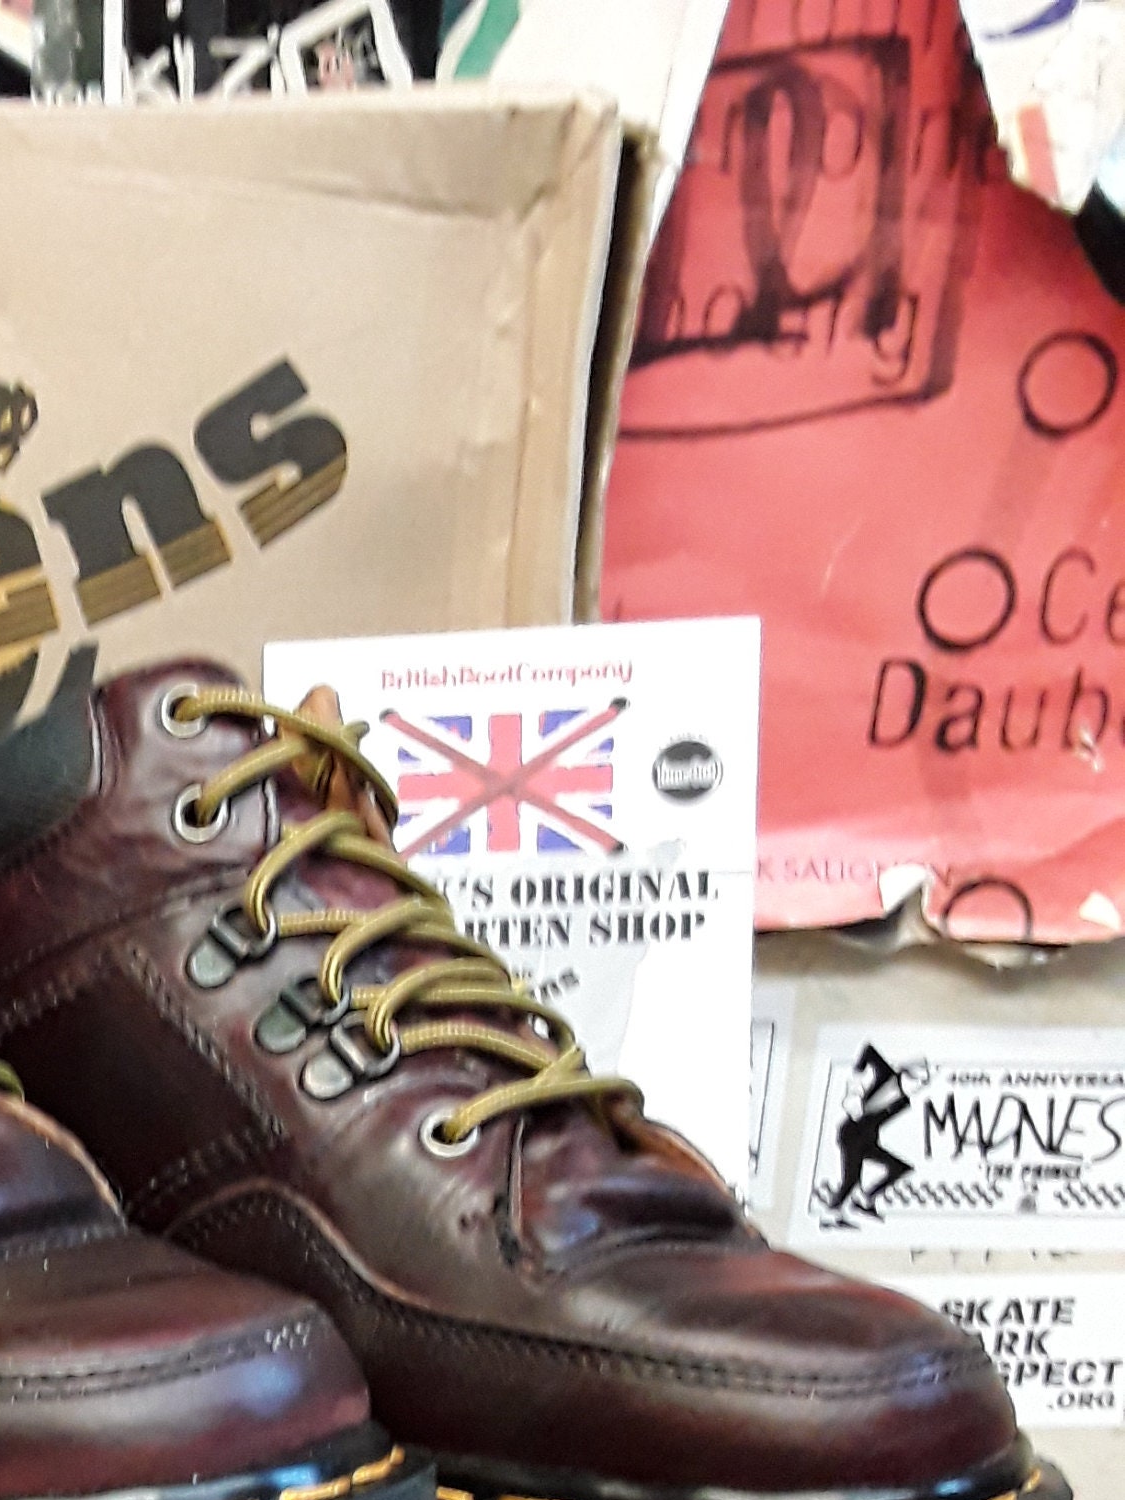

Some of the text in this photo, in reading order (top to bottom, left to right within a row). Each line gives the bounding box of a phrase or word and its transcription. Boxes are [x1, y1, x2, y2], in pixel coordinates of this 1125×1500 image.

[511, 869, 719, 906] ORIGINAL
[590, 911, 705, 945] SHOP
[941, 1297, 1076, 1326] SKATE
